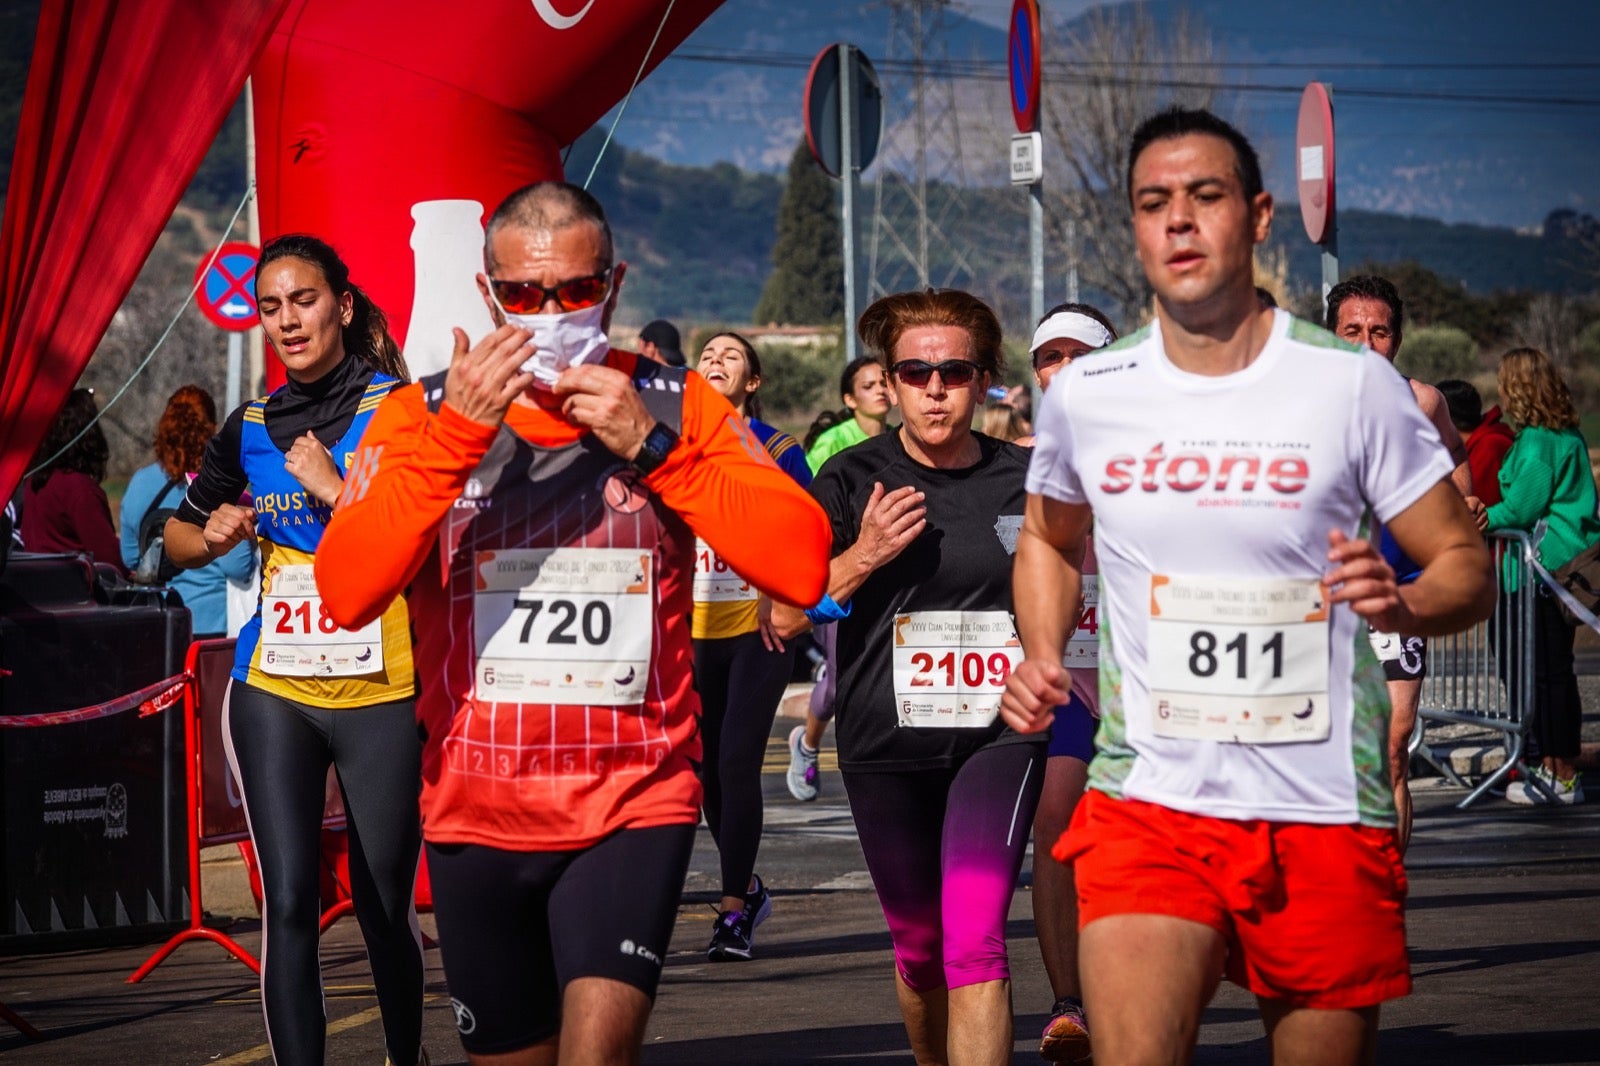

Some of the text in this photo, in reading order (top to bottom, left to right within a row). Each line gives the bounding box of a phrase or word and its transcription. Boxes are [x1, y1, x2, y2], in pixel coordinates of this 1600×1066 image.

[1180, 440, 1312, 450] THE RETURN
[1100, 441, 1310, 494] stone
[272, 511, 334, 527] GRANA
[273, 601, 362, 634] 218
[513, 599, 611, 645] 720
[910, 652, 1011, 687] 2109
[1188, 630, 1283, 679] 811
[472, 751, 484, 773] 2
[499, 754, 510, 777] 3
[563, 753, 575, 774] 5
